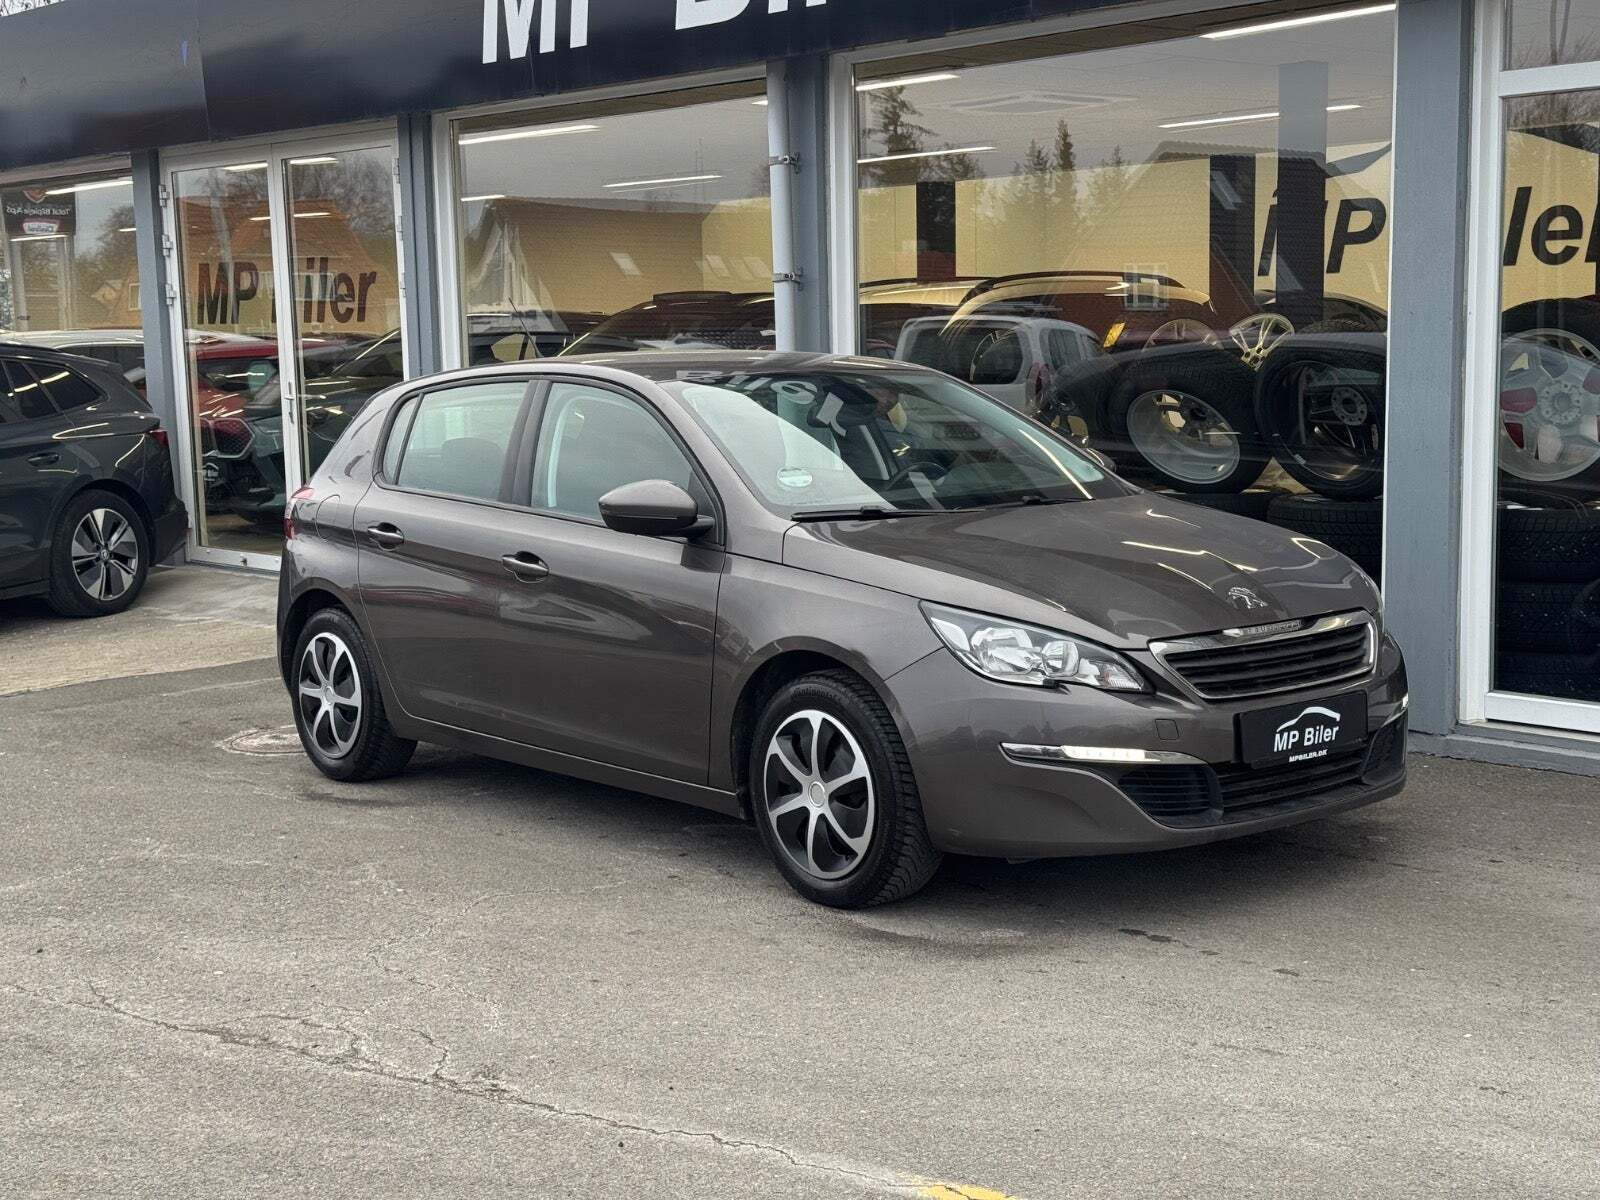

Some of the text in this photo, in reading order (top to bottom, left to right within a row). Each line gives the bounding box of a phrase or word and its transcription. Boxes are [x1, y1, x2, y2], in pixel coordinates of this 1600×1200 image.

[197, 256, 377, 325] MP iler
[1273, 725, 1340, 752] MP Biler
